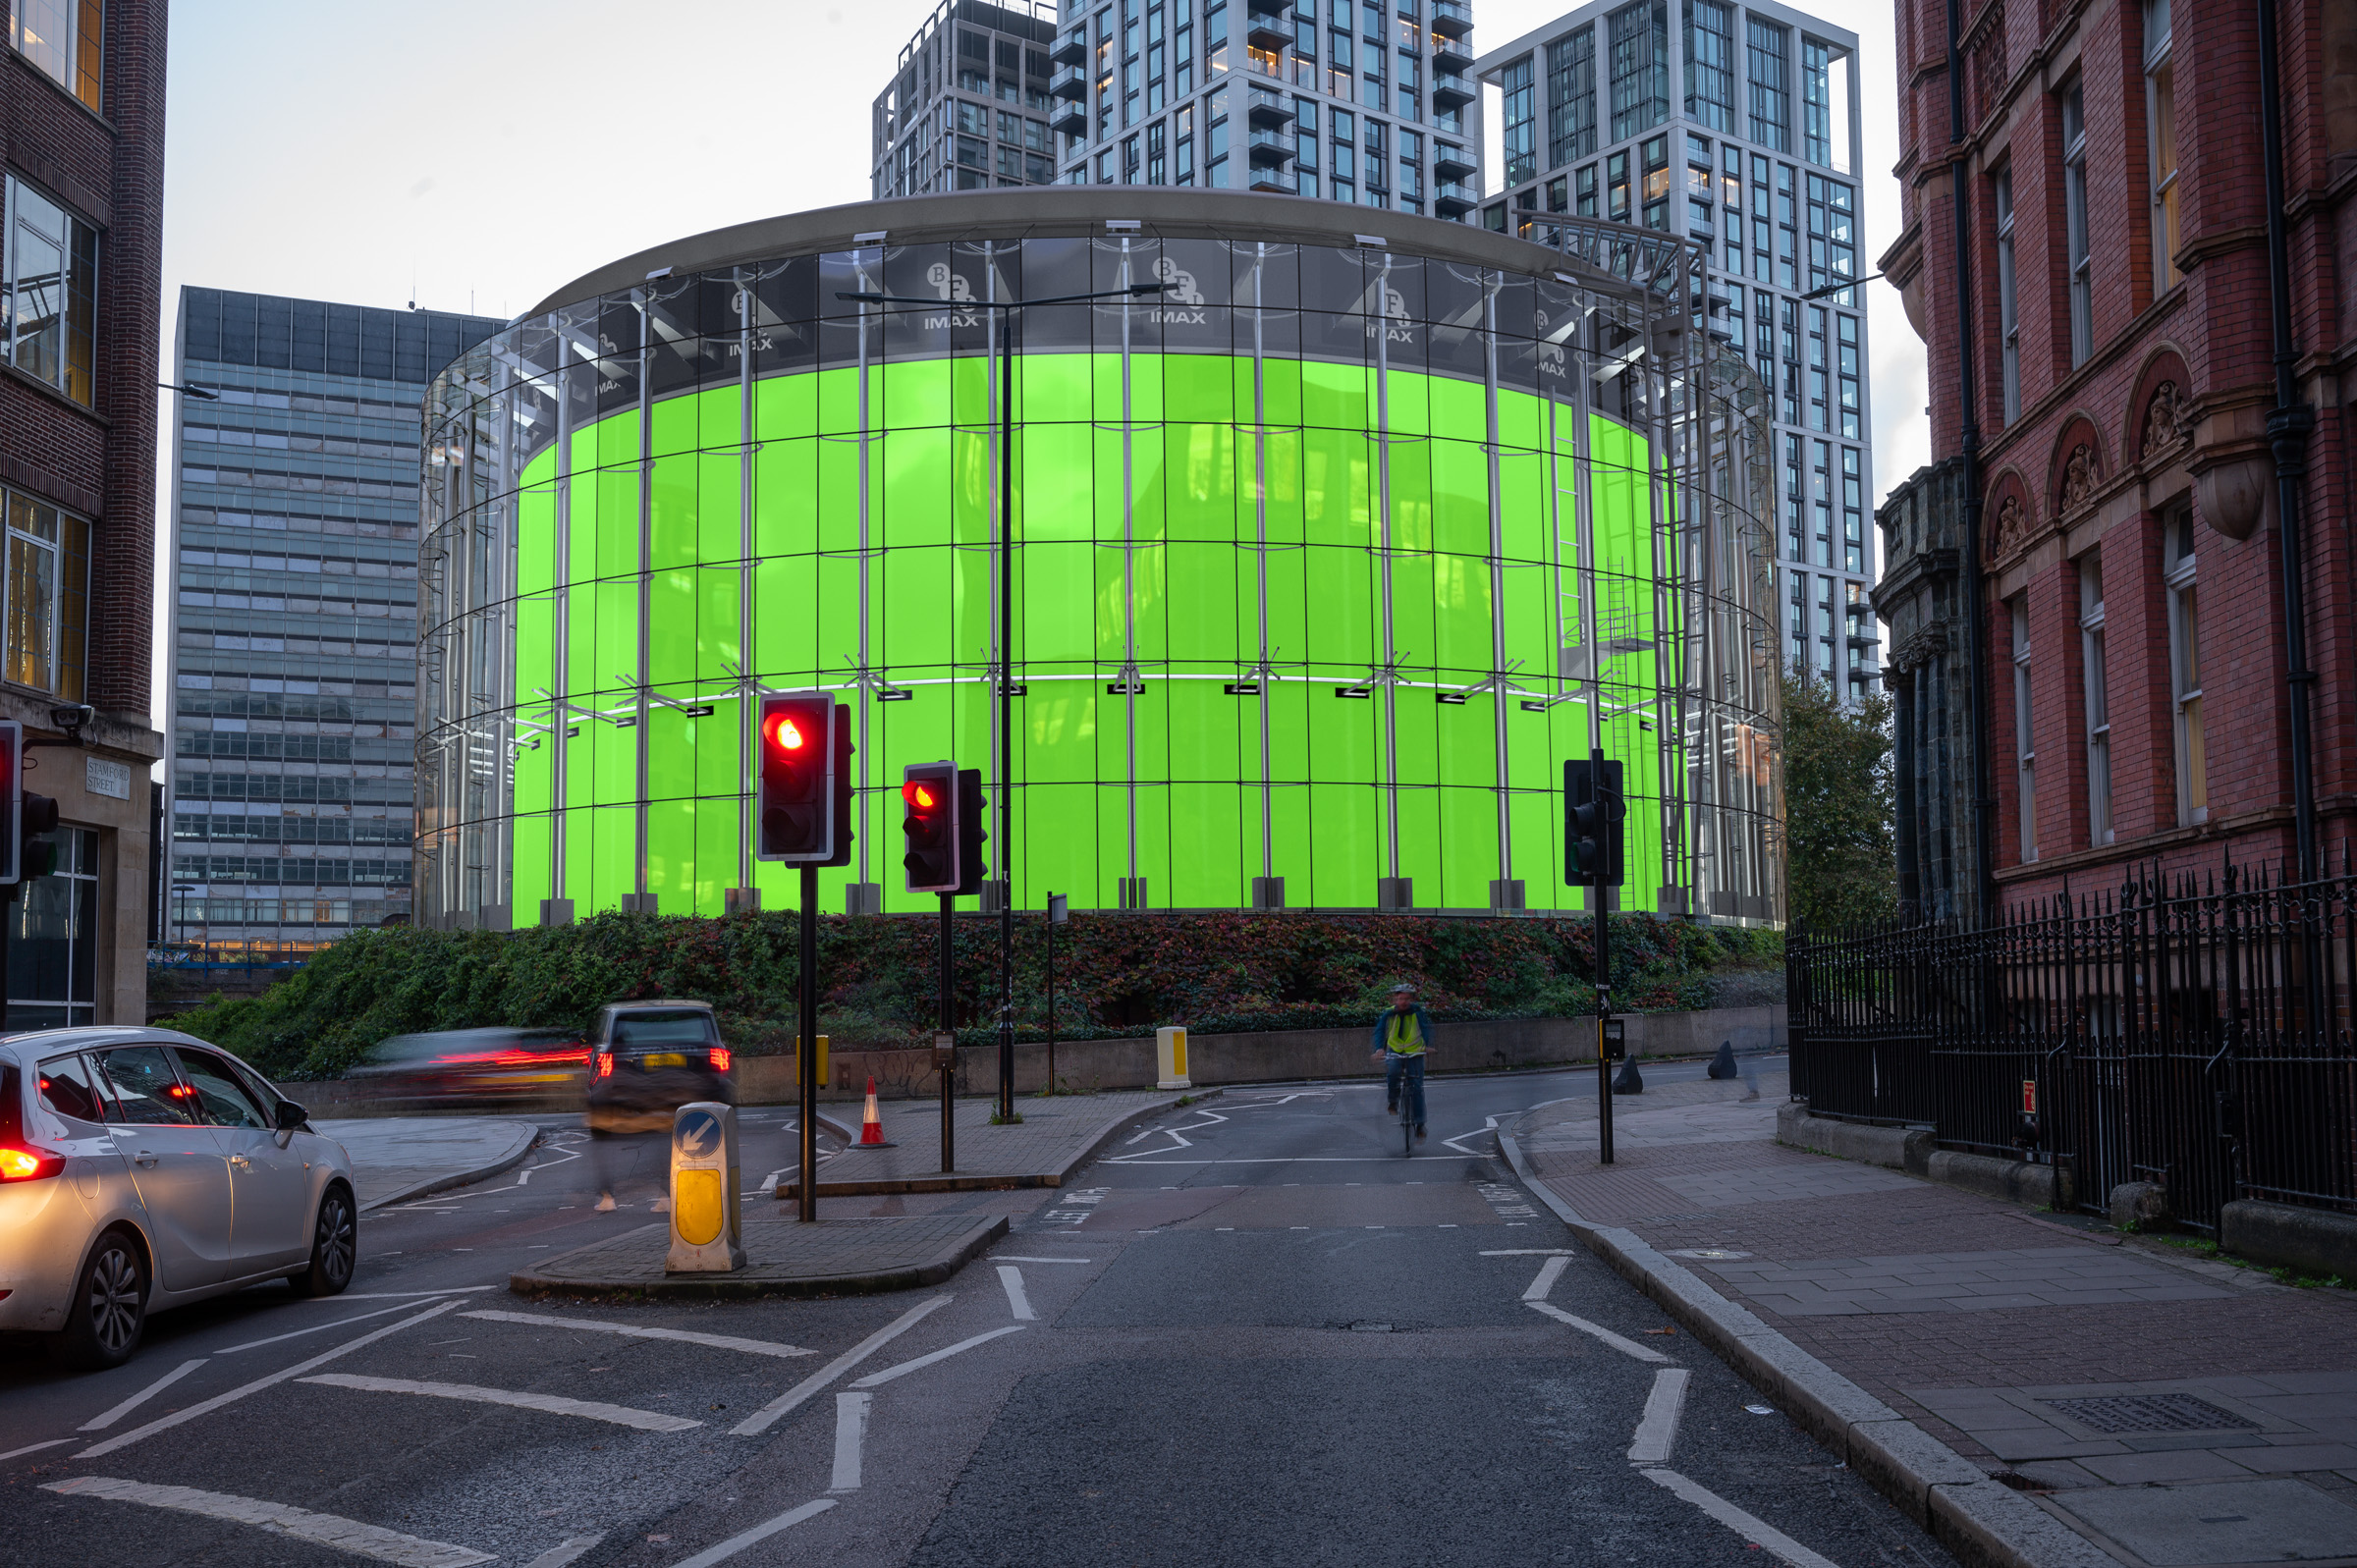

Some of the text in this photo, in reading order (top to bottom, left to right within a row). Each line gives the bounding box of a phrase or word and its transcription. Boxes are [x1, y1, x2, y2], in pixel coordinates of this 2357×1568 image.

[924, 315, 980, 330] IMAX
[1150, 311, 1206, 324] IMAX
[1534, 360, 1566, 379] MAX
[88, 761, 130, 782] STAMFORD
